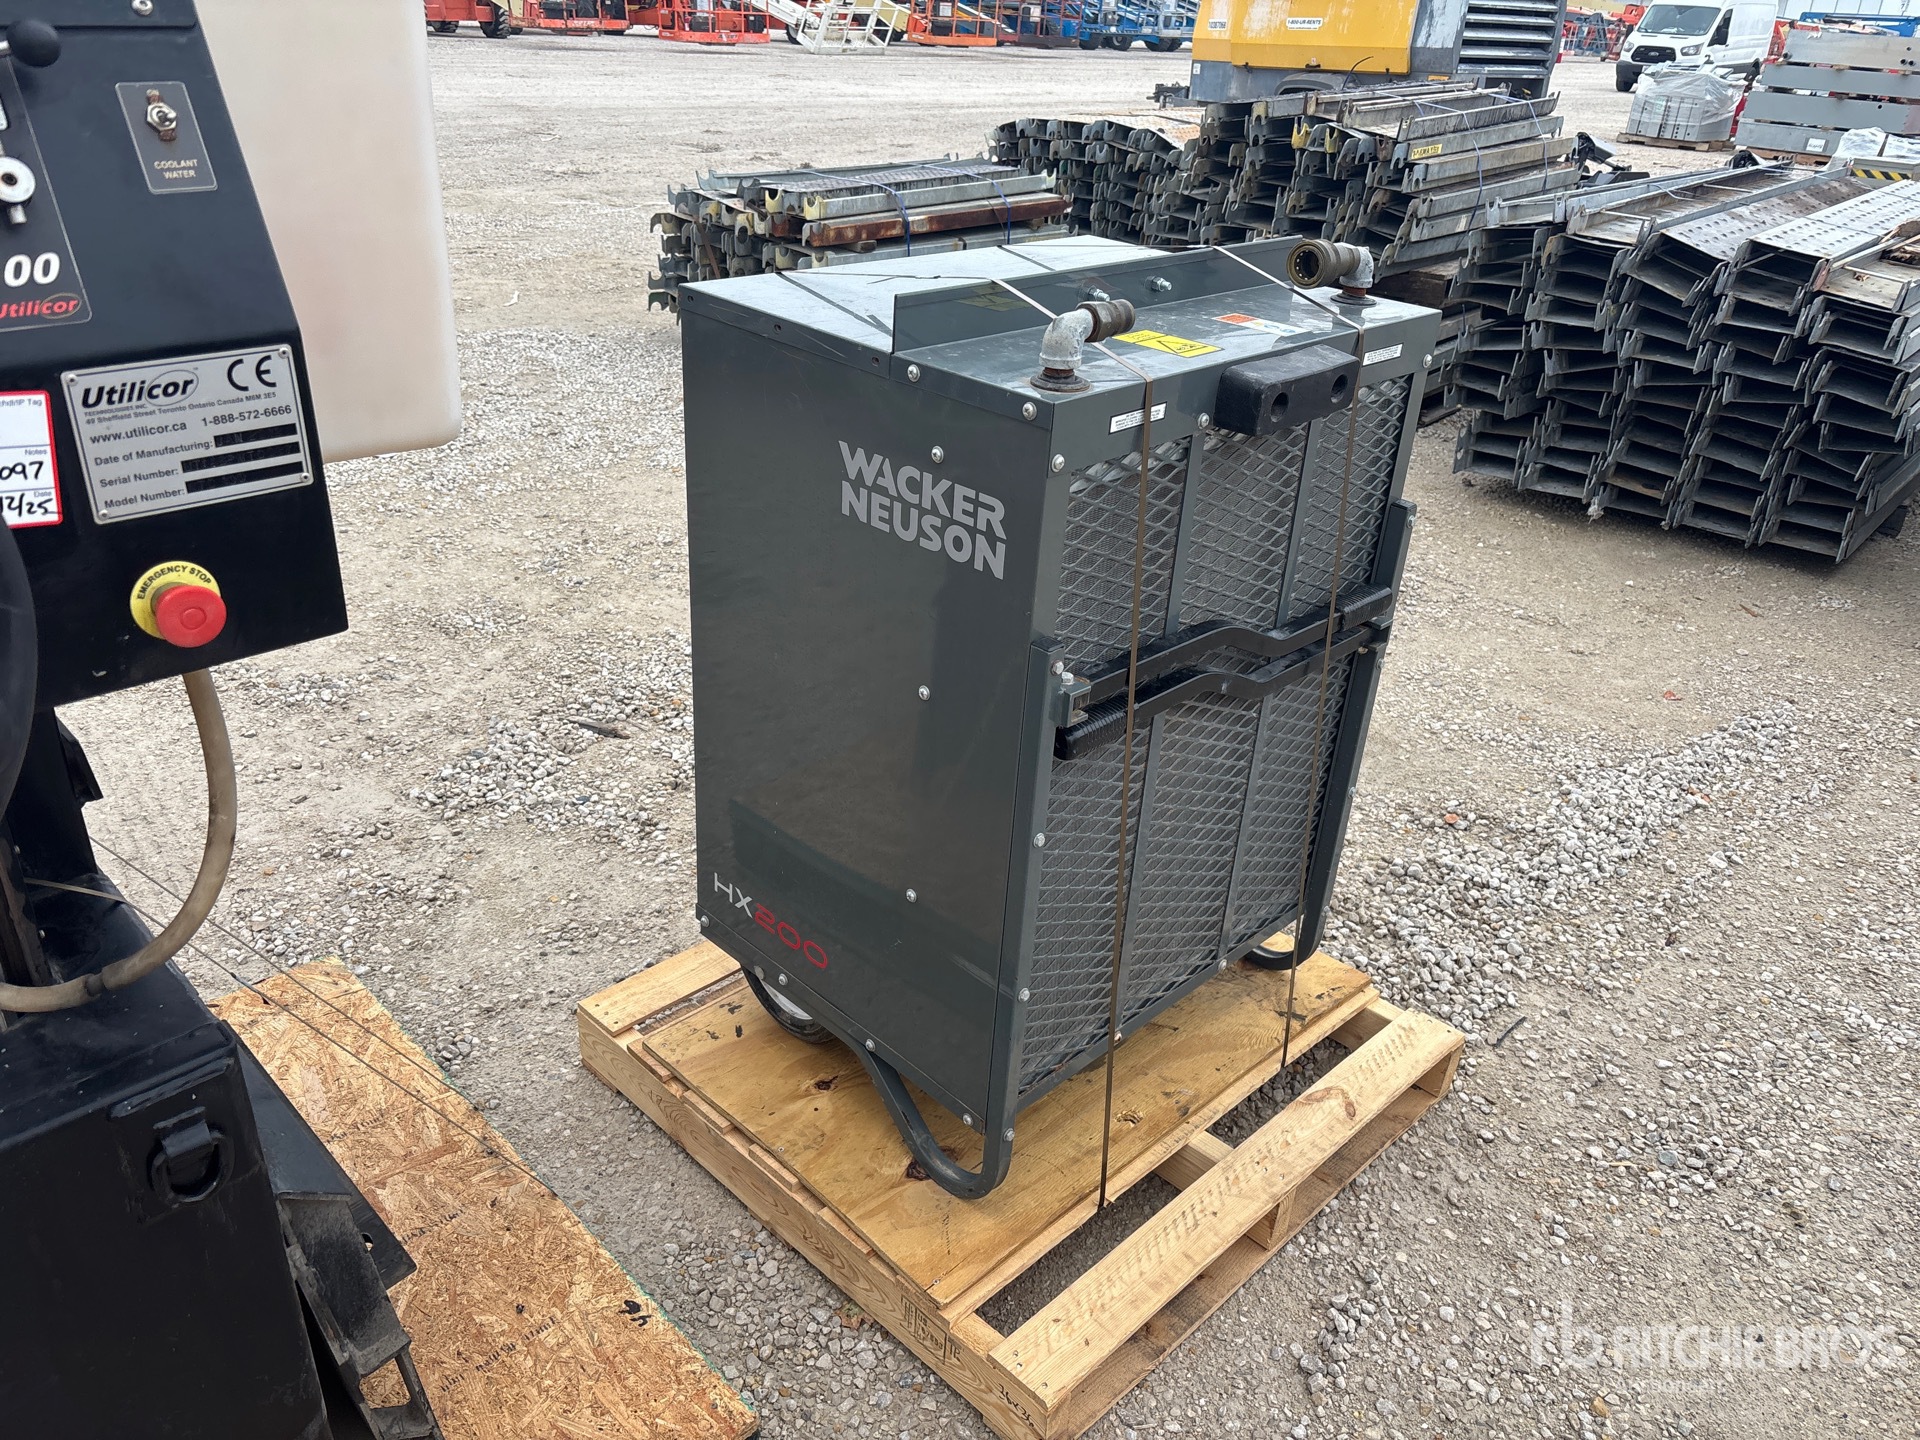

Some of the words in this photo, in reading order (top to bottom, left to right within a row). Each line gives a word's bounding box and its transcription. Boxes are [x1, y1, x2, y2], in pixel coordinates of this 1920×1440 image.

[153, 159, 197, 169] COOLANT
[163, 169, 196, 179] WATER
[4, 252, 60, 287] 00
[28, 399, 42, 407] Tag
[81, 380, 195, 409] Utilicor
[133, 409, 156, 418] Street
[157, 405, 187, 414] Toronto
[188, 401, 215, 410] Ontario
[217, 397, 244, 406] Canada
[90, 422, 187, 444] www.utilicor.ca
[202, 405, 292, 426] 1-888-572-6666
[94, 455, 119, 466] Date
[122, 452, 133, 462] of
[135, 440, 213, 459] Manufacturing:
[100, 472, 131, 488] Serial
[134, 468, 178, 481] Number:
[839, 440, 1007, 540] WACKER
[104, 496, 138, 508] Model
[140, 488, 185, 503] Number:
[841, 480, 1006, 580] NEUSON
[137, 565, 188, 599] EMERGENCY
[189, 567, 212, 584] STOP
[714, 872, 828, 969] HX200
